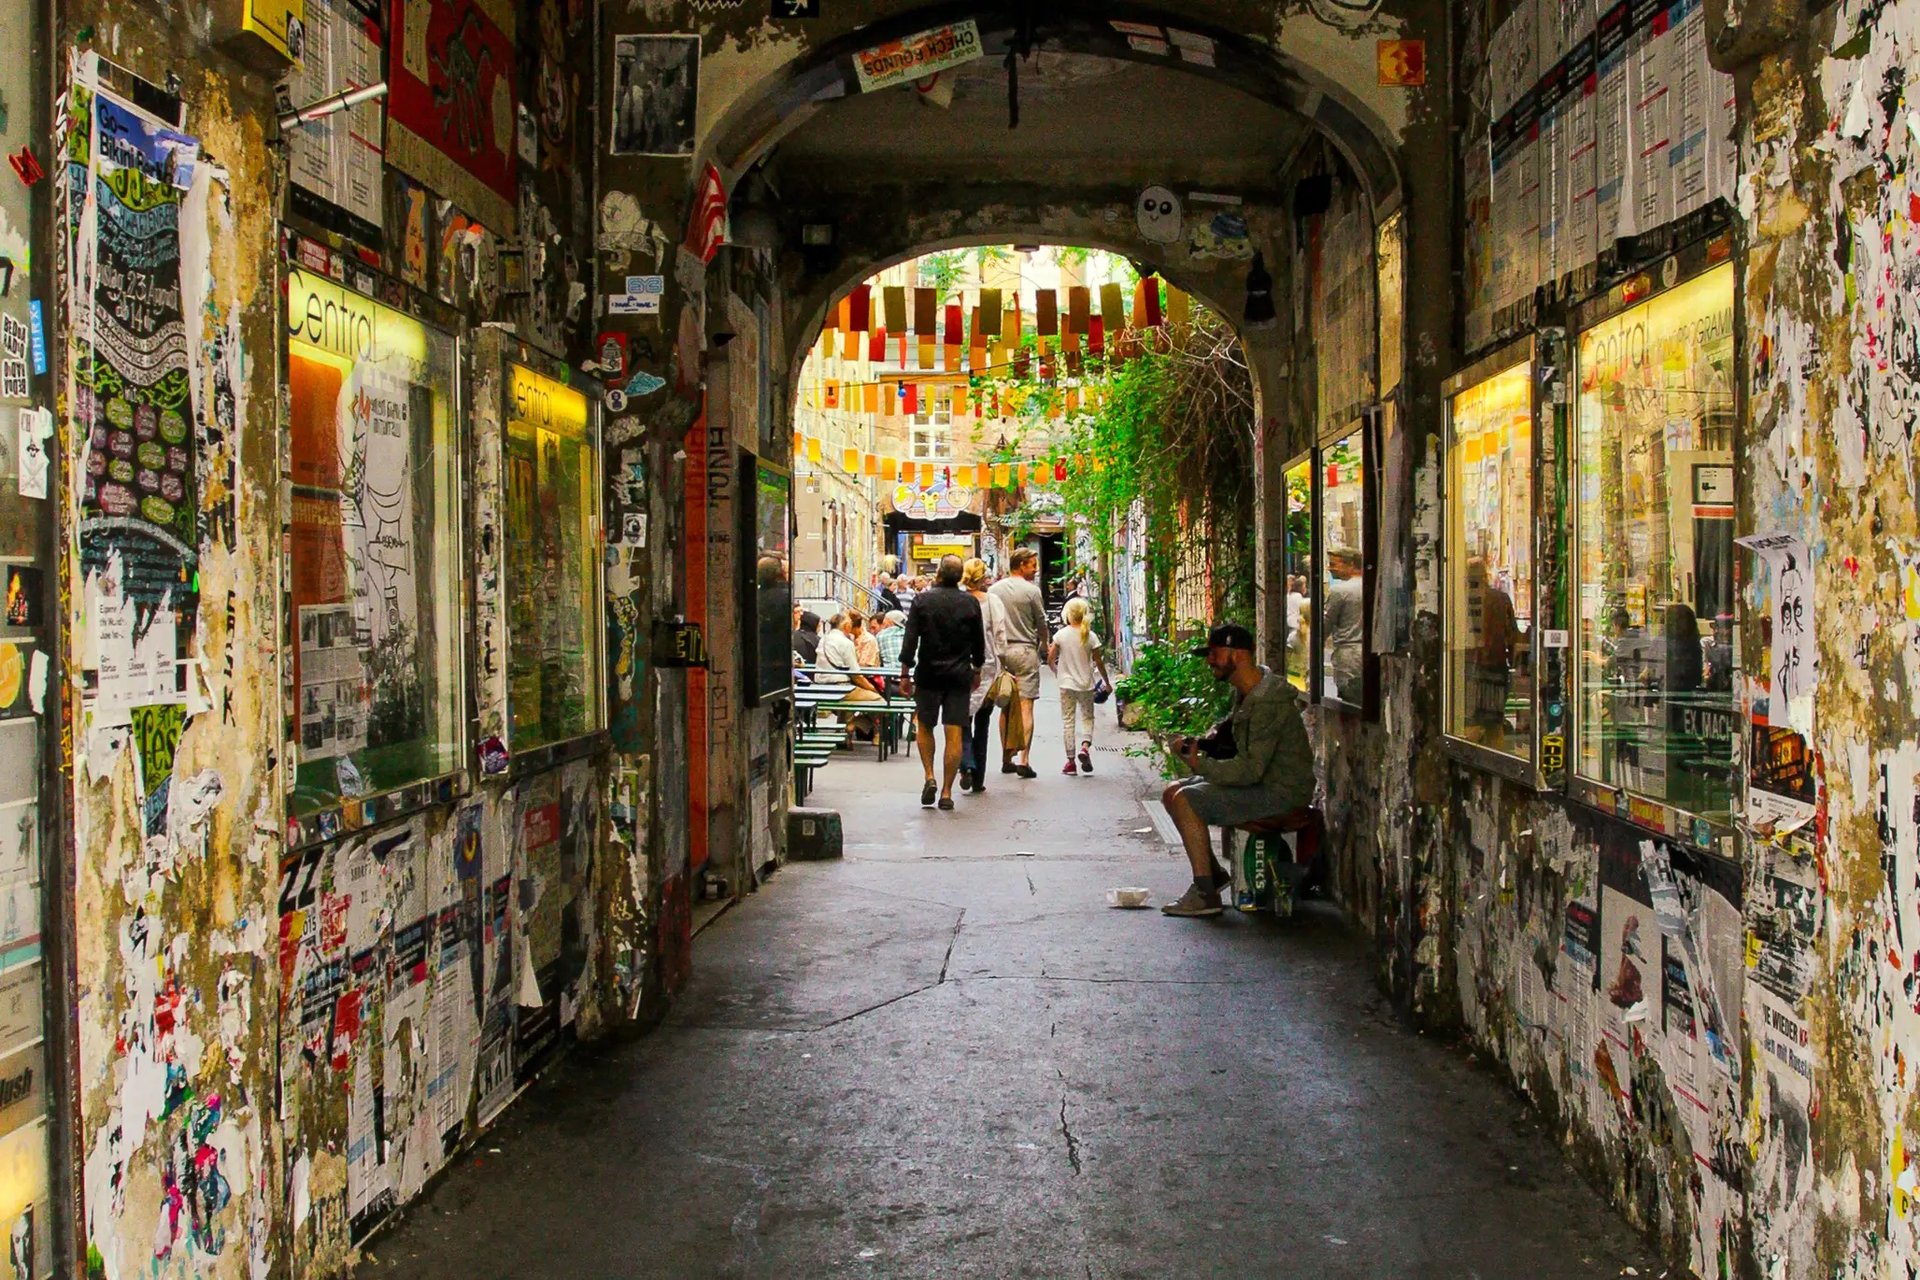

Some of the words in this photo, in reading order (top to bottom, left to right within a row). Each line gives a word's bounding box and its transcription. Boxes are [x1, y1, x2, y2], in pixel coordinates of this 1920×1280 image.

[288, 265, 376, 363] Central
[509, 370, 554, 427] entral
[1771, 1008, 1799, 1045] WIEDER
